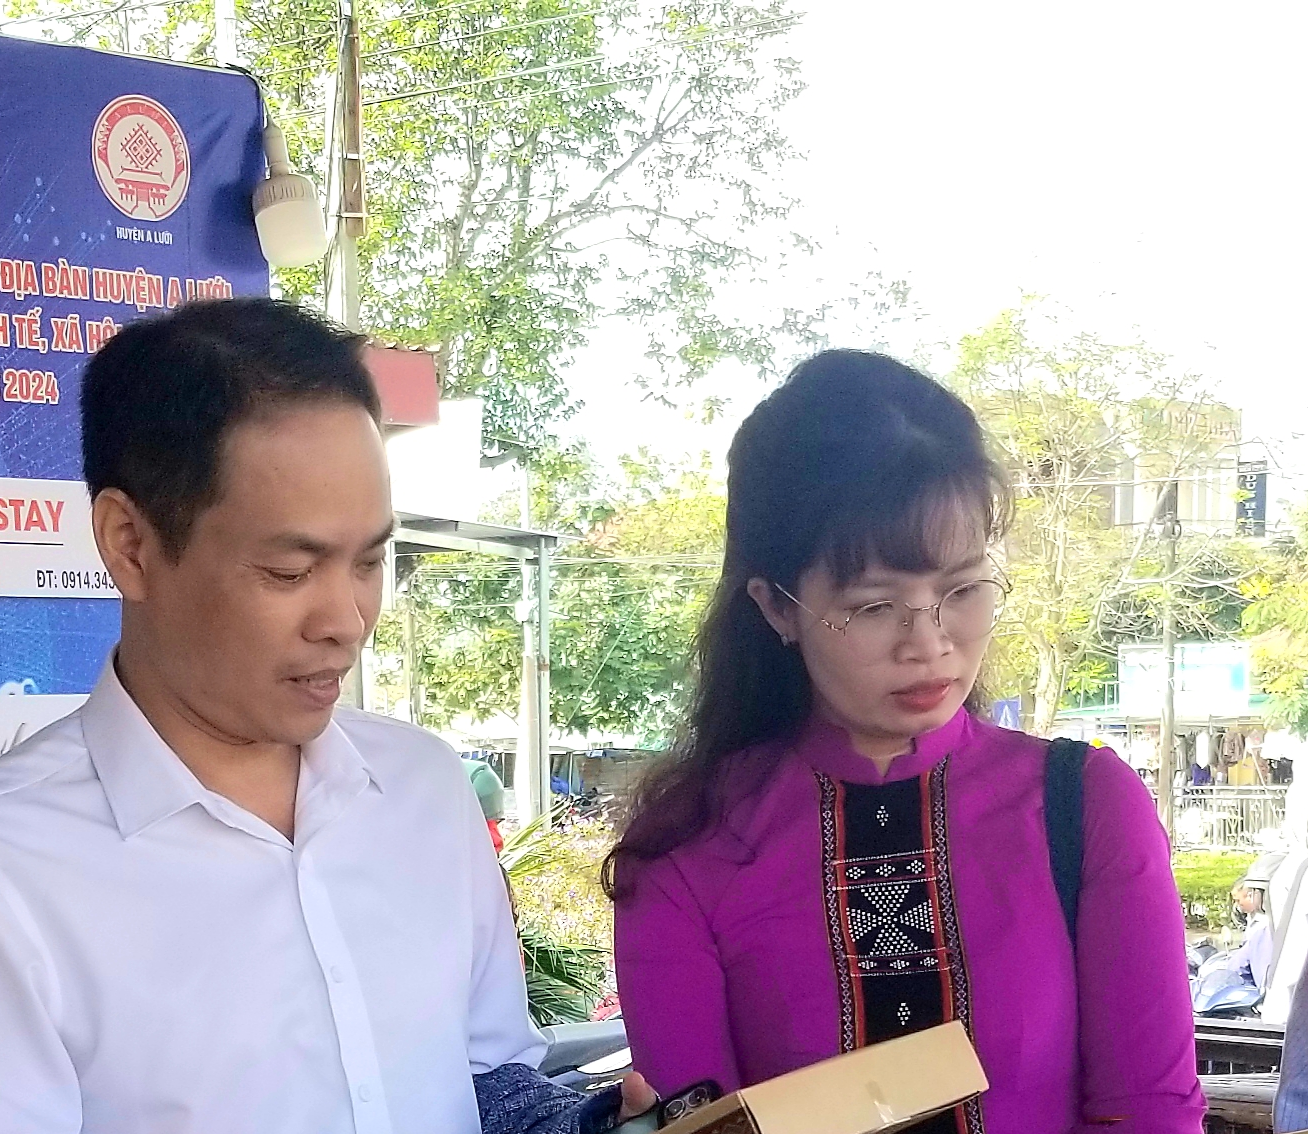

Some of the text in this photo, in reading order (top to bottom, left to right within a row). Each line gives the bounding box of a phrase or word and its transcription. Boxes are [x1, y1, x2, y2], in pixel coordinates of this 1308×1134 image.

[115, 226, 144, 243] HUYỆN
[146, 232, 153, 243] A
[42, 257, 89, 301] BÀN
[93, 267, 163, 313] HUYỆN
[166, 276, 183, 308] A
[13, 307, 47, 353] TẾ,
[51, 313, 84, 353] XÃ
[3, 370, 60, 405] 2024
[36, 569, 59, 589] ĐT:
